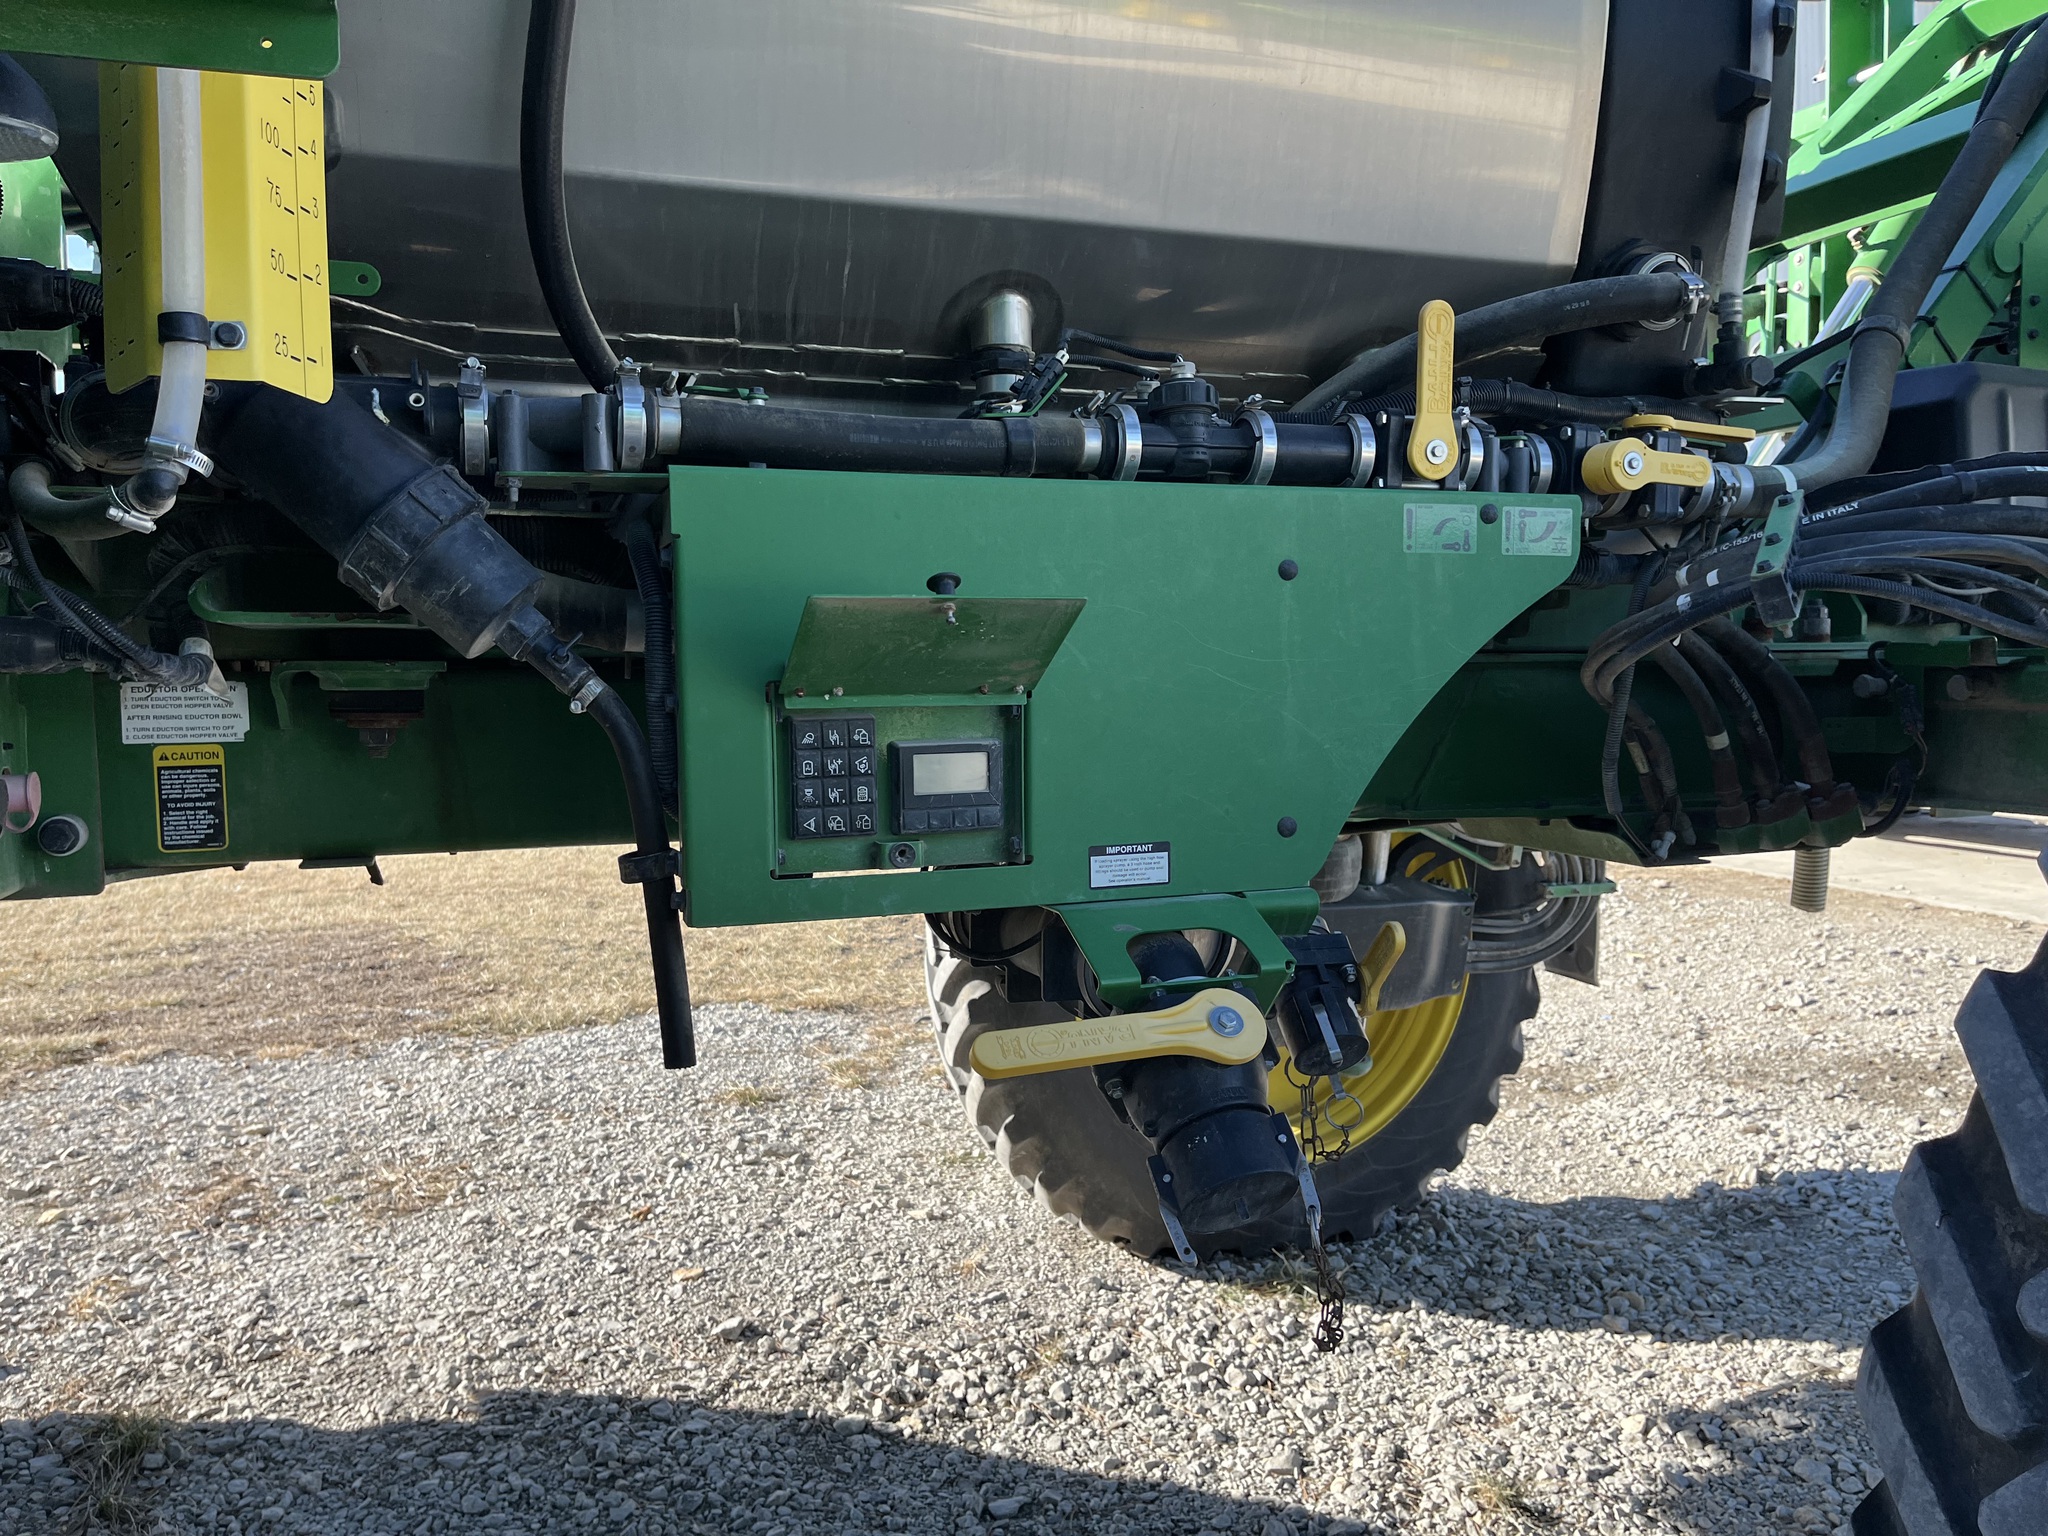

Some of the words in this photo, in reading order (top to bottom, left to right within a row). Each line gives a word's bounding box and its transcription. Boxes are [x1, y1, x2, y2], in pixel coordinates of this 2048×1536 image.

[309, 84, 315, 106] 5
[261, 117, 279, 149] 100
[311, 139, 316, 160] 4
[266, 177, 282, 208] 75
[313, 197, 318, 218] 3
[271, 248, 284, 274] 50
[315, 264, 321, 286] 2
[275, 333, 288, 357] 25
[1812, 512, 1824, 521] IN
[1827, 502, 1859, 517] ITALY
[171, 752, 219, 760] CAUTION
[1106, 844, 1153, 854] IMPORTANT
